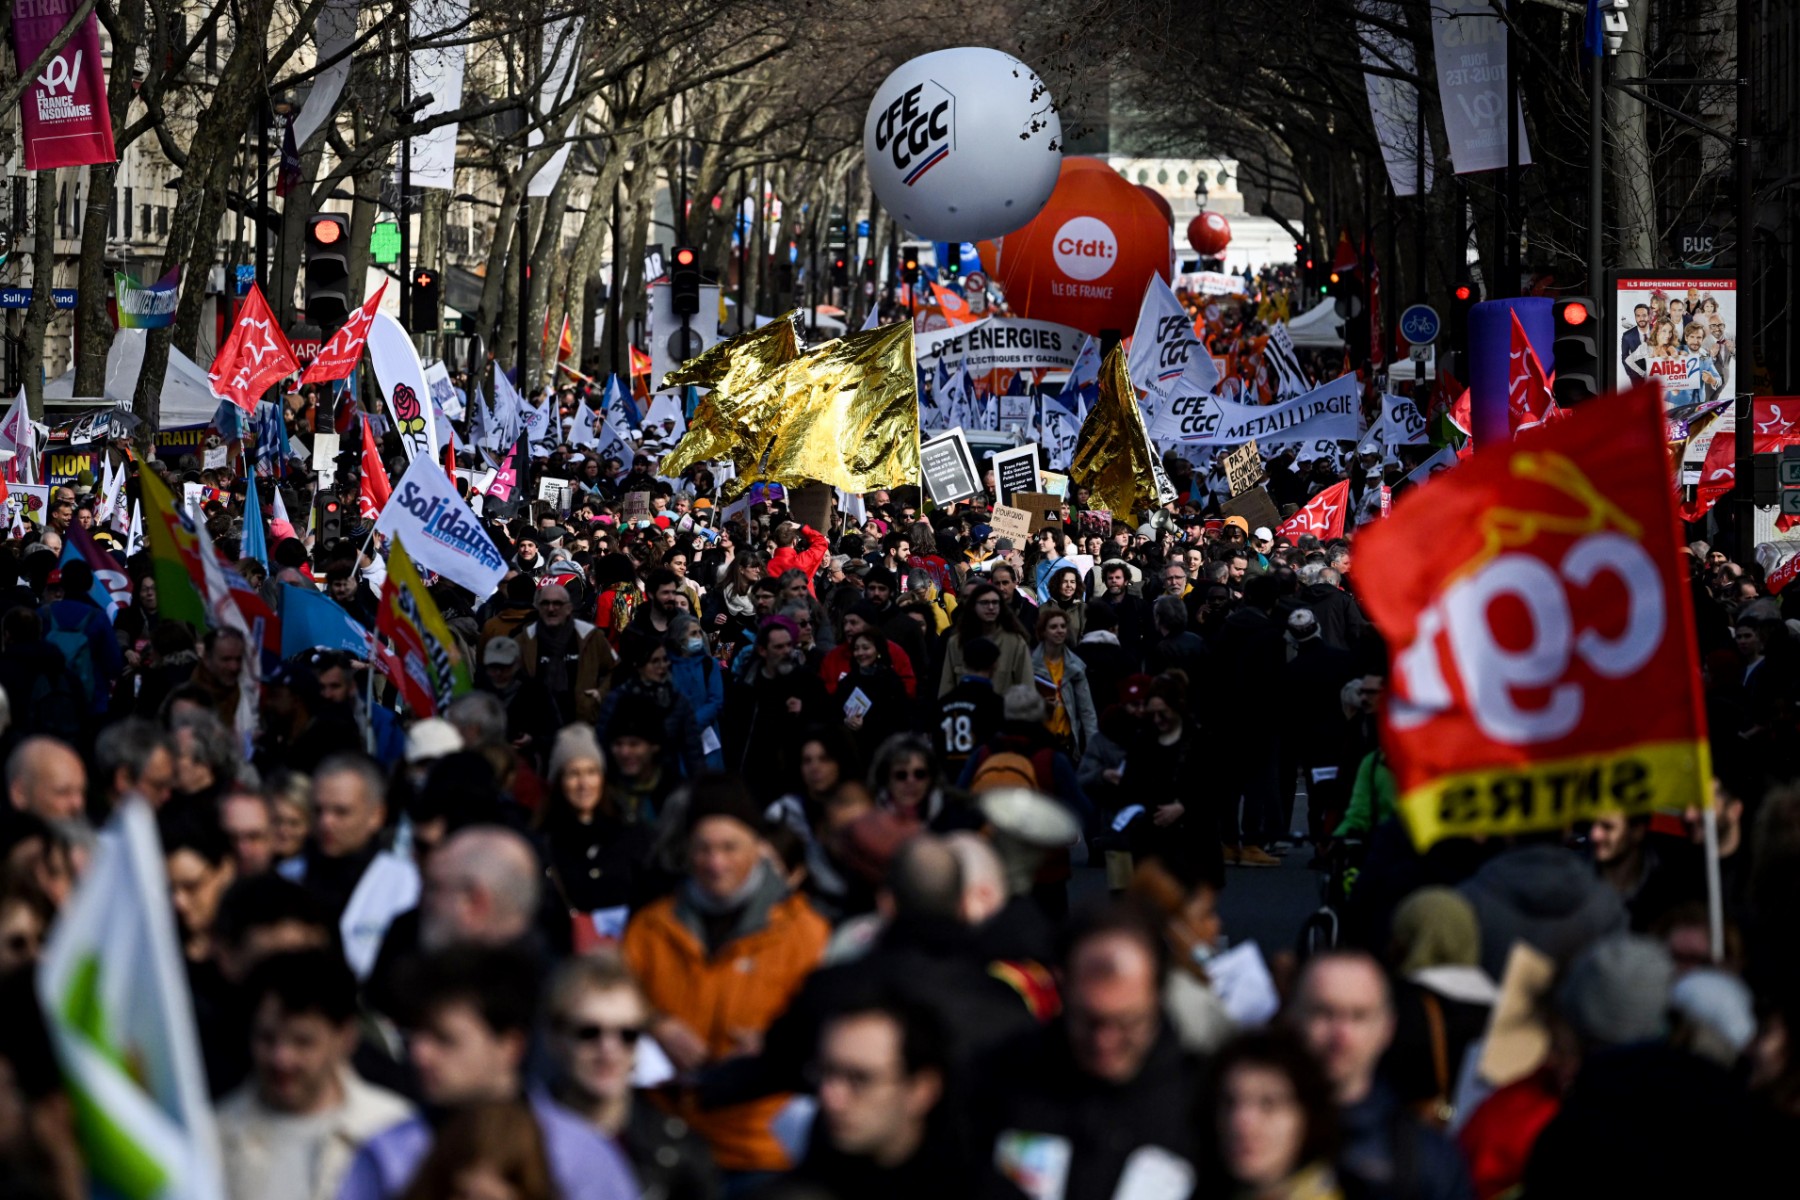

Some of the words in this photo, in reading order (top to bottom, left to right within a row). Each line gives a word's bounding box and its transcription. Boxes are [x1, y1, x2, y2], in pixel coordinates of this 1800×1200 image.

[36, 89, 45, 98] LA
[38, 95, 74, 111] FRANCE
[39, 104, 92, 120] INSOUMISE
[876, 83, 924, 151] CFE
[892, 100, 949, 169] CGC
[1683, 236, 1713, 252] BUS
[3, 293, 26, 304] Sully
[53, 294, 73, 303] land
[1066, 284, 1077, 296] DE
[1080, 285, 1113, 299] FRANCE
[1157, 315, 1192, 343] CFE
[931, 336, 963, 358] CFE
[1160, 339, 1200, 368] CGC
[1649, 359, 1687, 376] Alibi
[1686, 357, 1700, 379] 2
[1171, 397, 1208, 416] CFE
[1225, 395, 1352, 439] METALLURGIE
[1180, 414, 1219, 433] CGC
[51, 455, 90, 476] NON
[1229, 450, 1244, 469] PAS
[1233, 477, 1249, 495] SUR
[995, 507, 1024, 520] POURQUOI
[941, 715, 973, 752] 18
